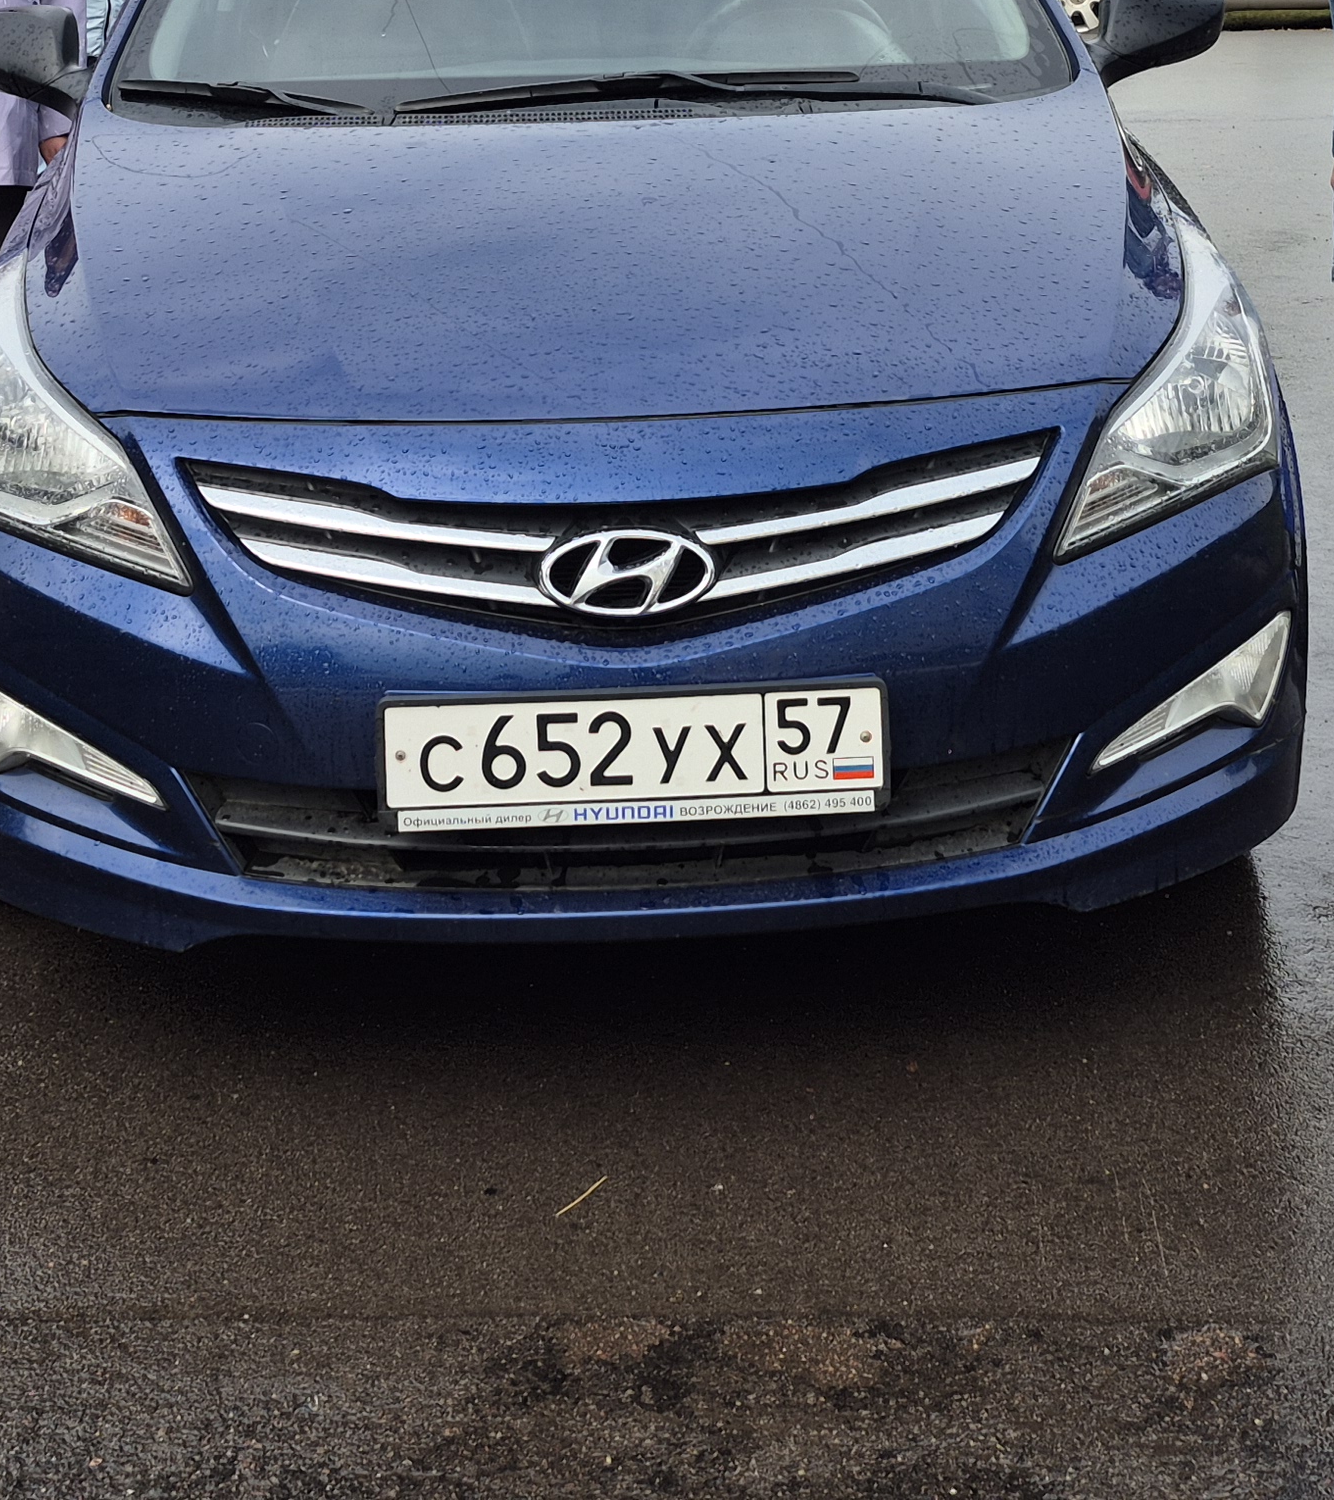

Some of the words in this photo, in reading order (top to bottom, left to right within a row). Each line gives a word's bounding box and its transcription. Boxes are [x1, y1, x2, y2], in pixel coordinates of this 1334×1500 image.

[420, 711, 748, 792] С652УХ
[777, 696, 851, 755] 57
[773, 759, 829, 782] RUS
[403, 814, 492, 827] Официальный
[495, 813, 532, 825] дилер
[573, 804, 674, 821] HYUNDAI
[680, 803, 777, 817] ВОЗРОЖДЕНИЕ
[783, 798, 821, 812] (4862)
[825, 798, 846, 808] 495
[850, 796, 872, 807] 400
